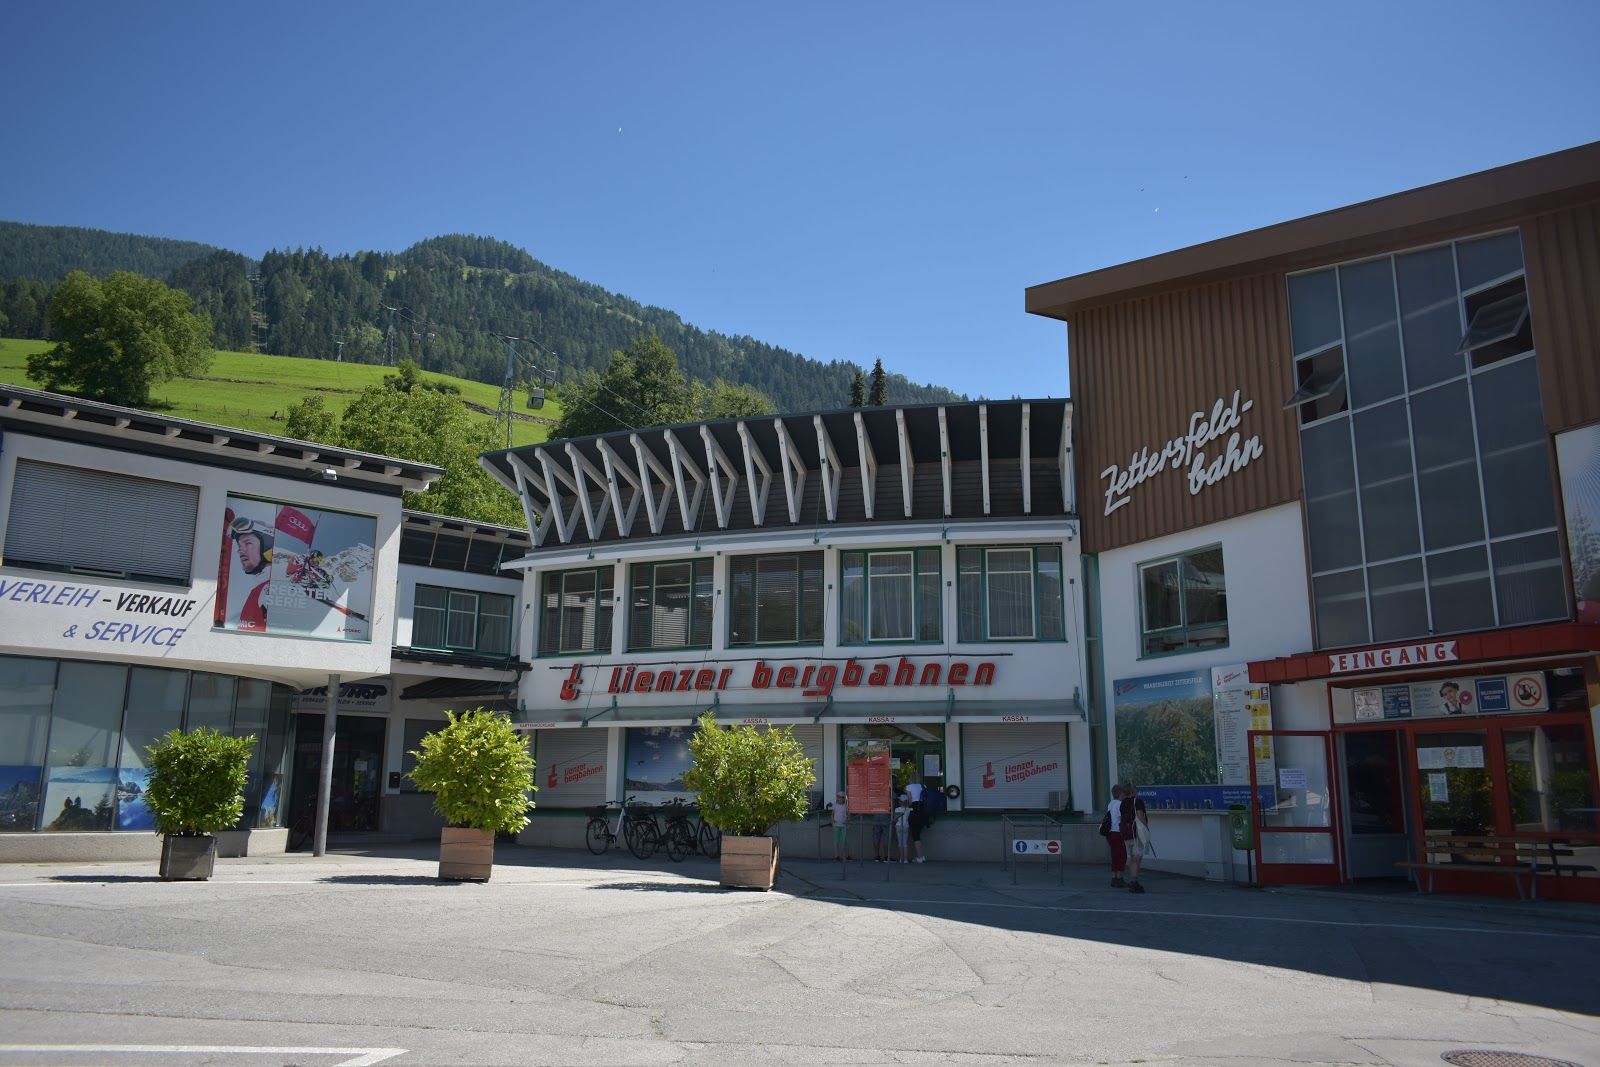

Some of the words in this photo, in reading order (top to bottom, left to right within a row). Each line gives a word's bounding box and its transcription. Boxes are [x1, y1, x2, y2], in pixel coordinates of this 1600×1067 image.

[1188, 432, 1264, 496] bahn
[0, 579, 100, 608] VERLEIH
[115, 592, 196, 618] VERKAUF
[265, 595, 308, 610] SERIE
[63, 625, 78, 638] &
[84, 620, 188, 647] SERVICE
[1338, 643, 1447, 671] EINGANG
[751, 656, 996, 697] bergbahnen
